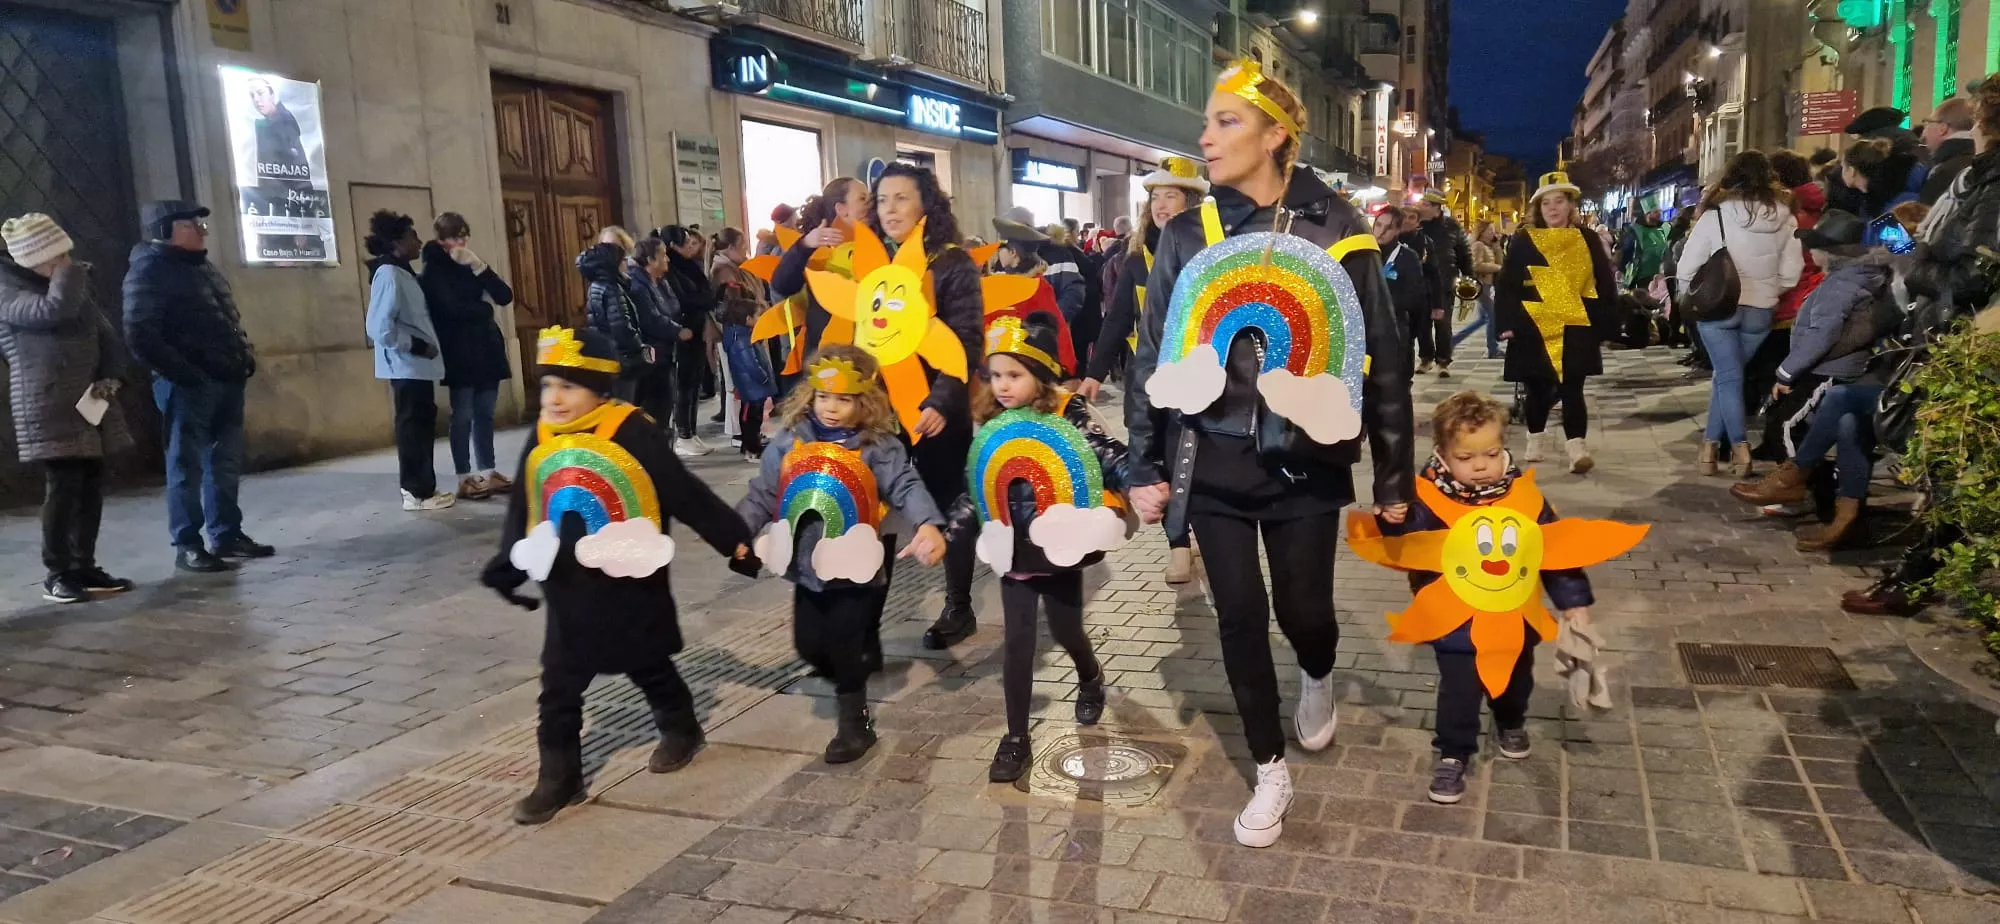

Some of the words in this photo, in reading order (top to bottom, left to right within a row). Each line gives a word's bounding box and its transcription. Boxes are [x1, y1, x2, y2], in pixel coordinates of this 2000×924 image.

[495, 2, 511, 25] 21
[741, 55, 767, 82] IN
[912, 94, 961, 131] INSIDE
[257, 163, 309, 177] REBAJAS
